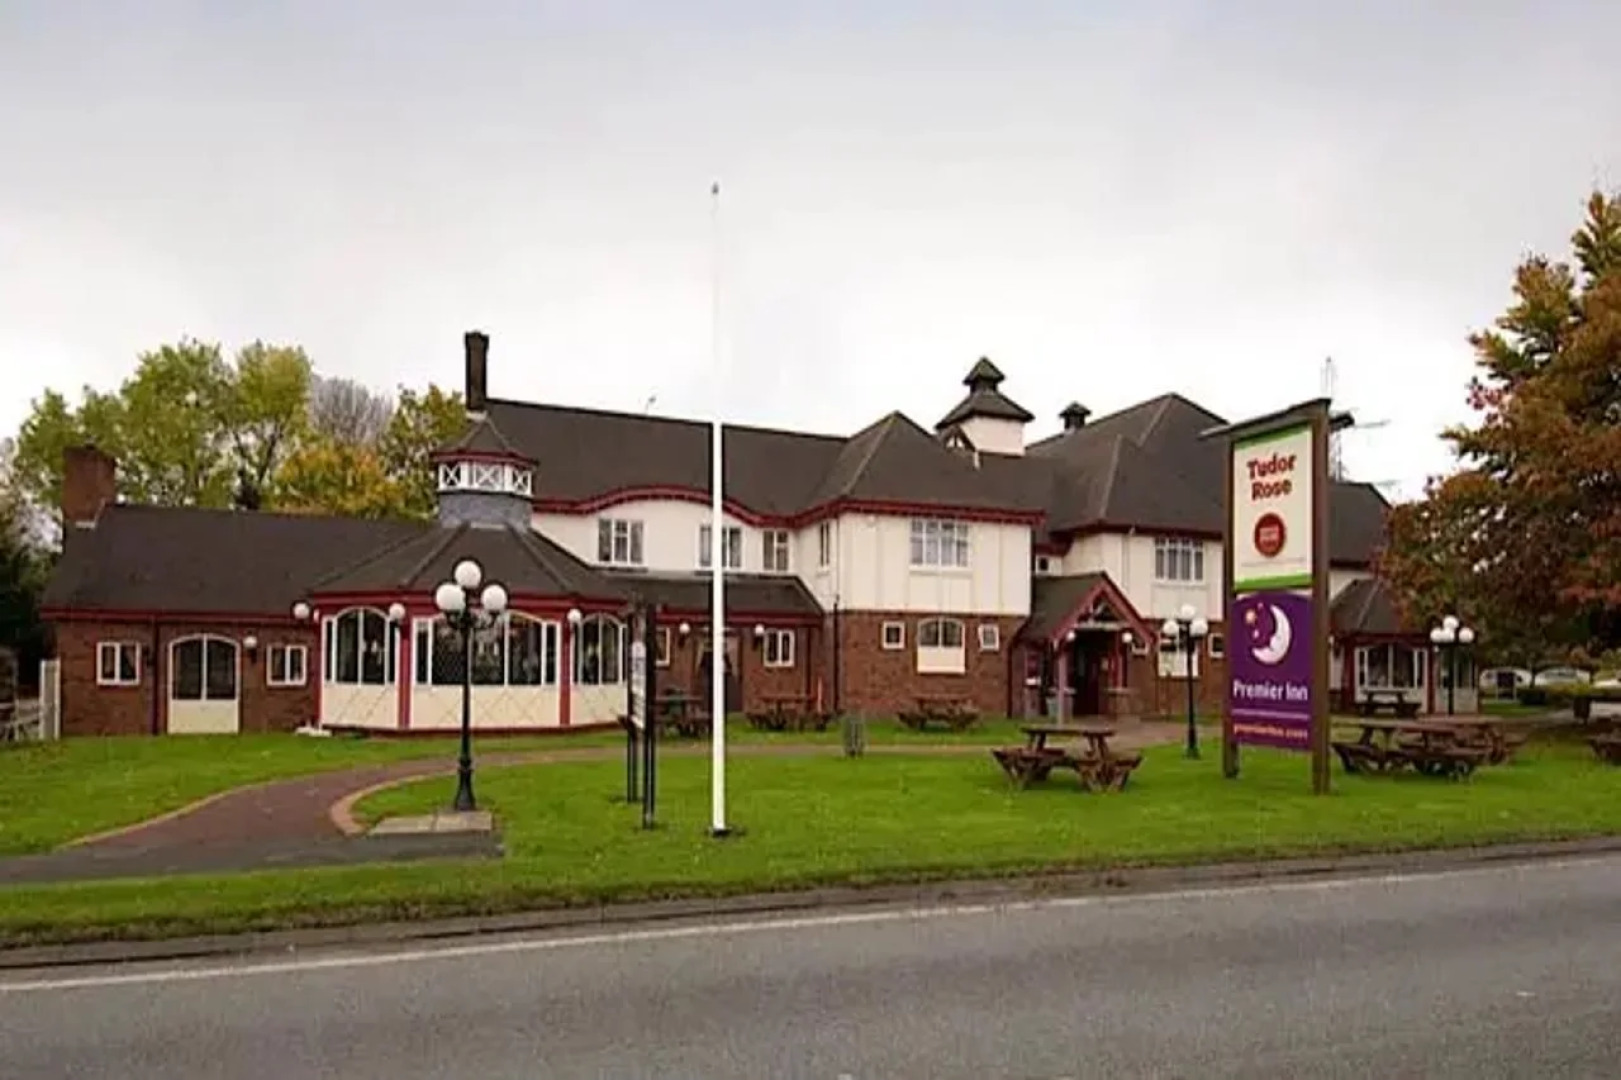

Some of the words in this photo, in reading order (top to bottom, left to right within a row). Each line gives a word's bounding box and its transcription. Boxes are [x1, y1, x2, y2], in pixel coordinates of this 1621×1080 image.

[1247, 453, 1297, 479] Tudor
[1252, 479, 1293, 501] Rose
[1233, 679, 1283, 700] Premier
[1286, 681, 1308, 701] Inn
